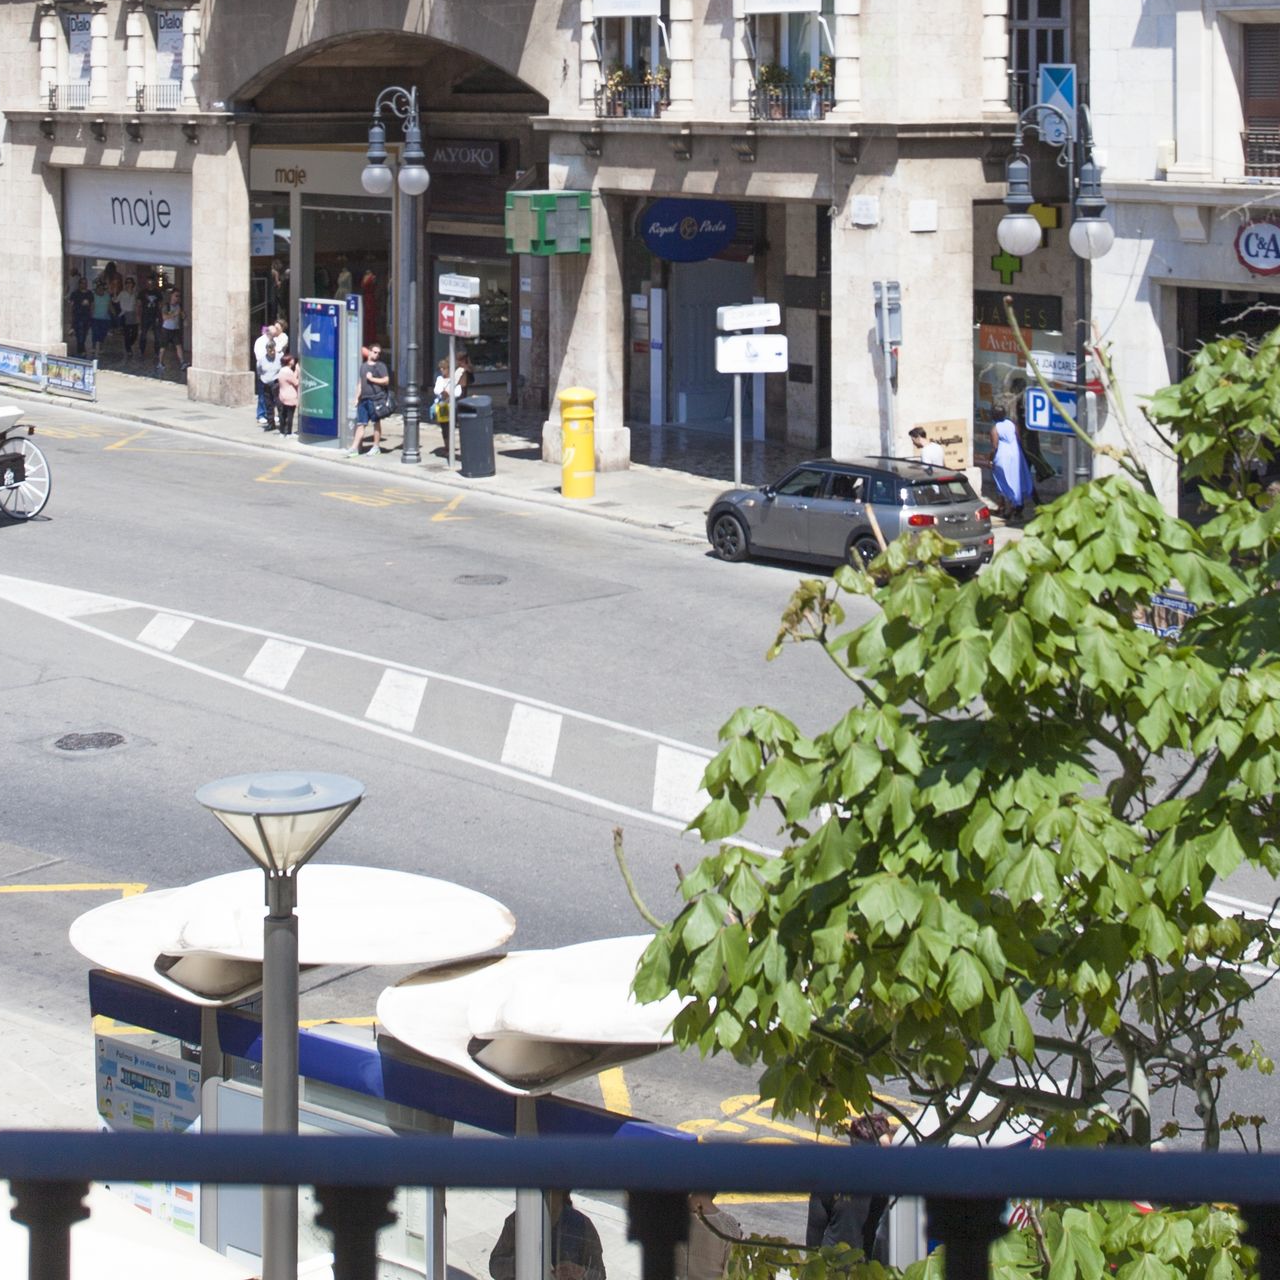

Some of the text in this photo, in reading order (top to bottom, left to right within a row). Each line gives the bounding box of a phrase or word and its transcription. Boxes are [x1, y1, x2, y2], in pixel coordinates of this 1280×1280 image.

[70, 15, 90, 32] Dialo
[159, 12, 183, 30] Dialo
[433, 147, 494, 168] MYOKO
[275, 165, 307, 188] maje
[110, 189, 171, 236] maje
[648, 221, 678, 238] Royal
[1033, 394, 1046, 422] P
